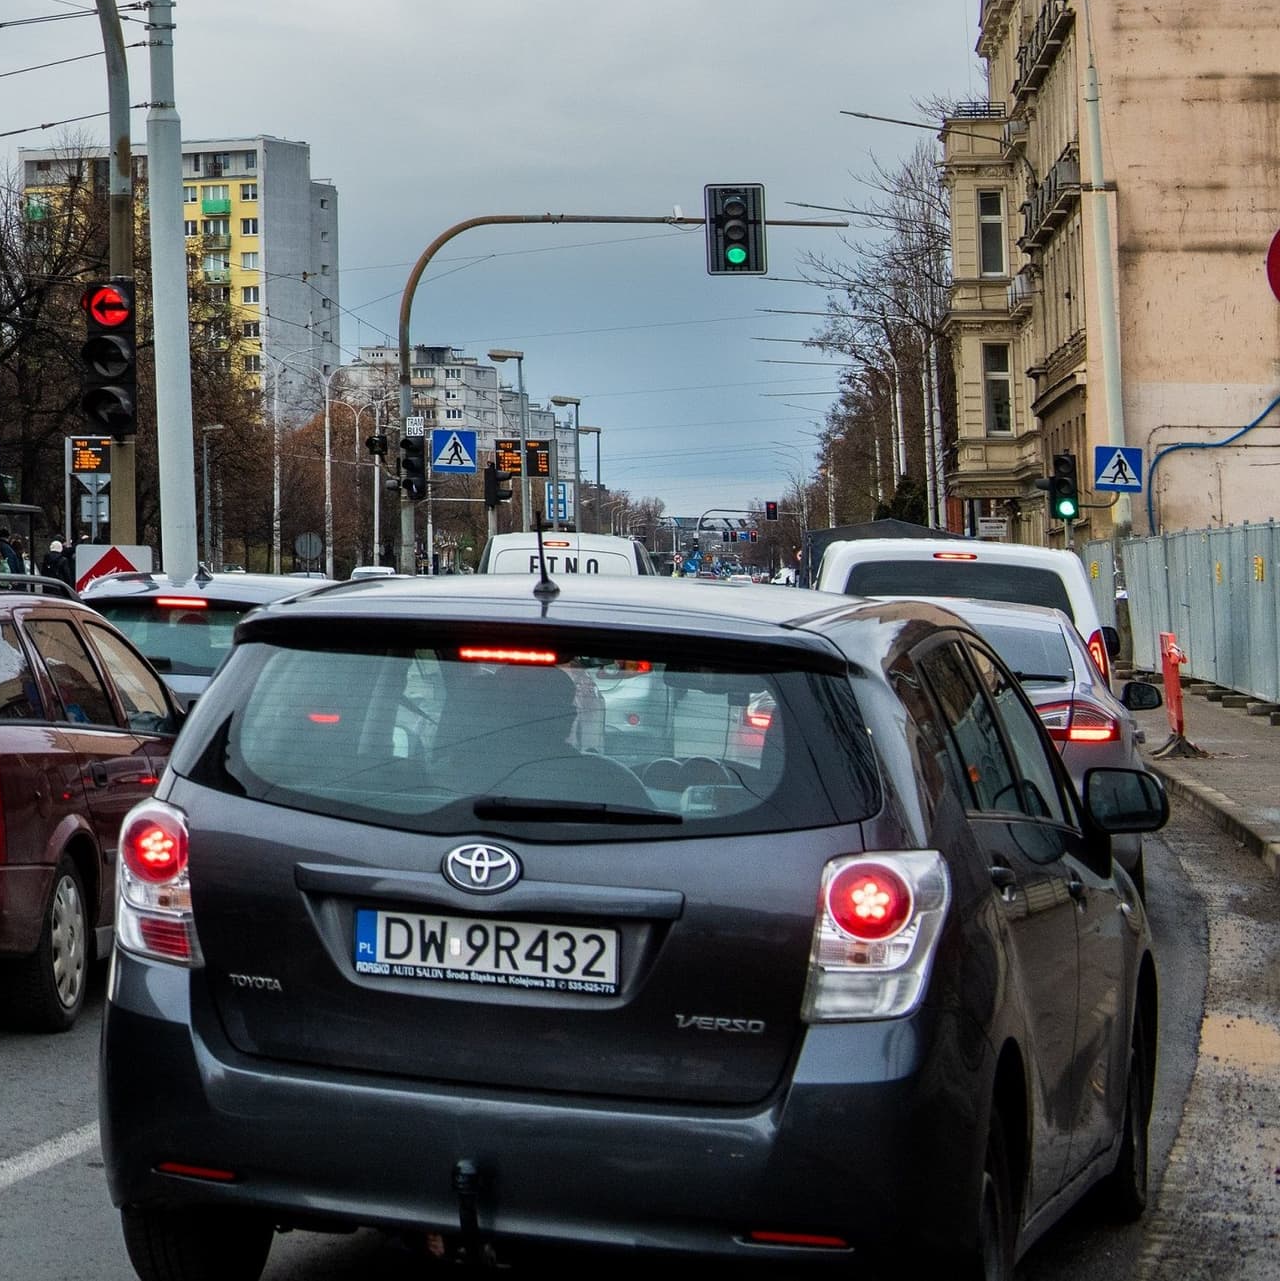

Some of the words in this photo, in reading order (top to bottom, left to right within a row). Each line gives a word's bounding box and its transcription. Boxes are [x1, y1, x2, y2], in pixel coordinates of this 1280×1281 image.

[408, 426, 423, 435] BUS
[359, 942, 374, 954] PL
[384, 917, 447, 963] DW
[465, 923, 607, 978] 9R432
[229, 973, 283, 993] TOYOTA
[392, 965, 415, 977] AUTO
[416, 967, 444, 979] SALON
[446, 968, 469, 980] Środa
[508, 975, 545, 988] Kolejowa
[675, 1014, 766, 1034] VERSO
